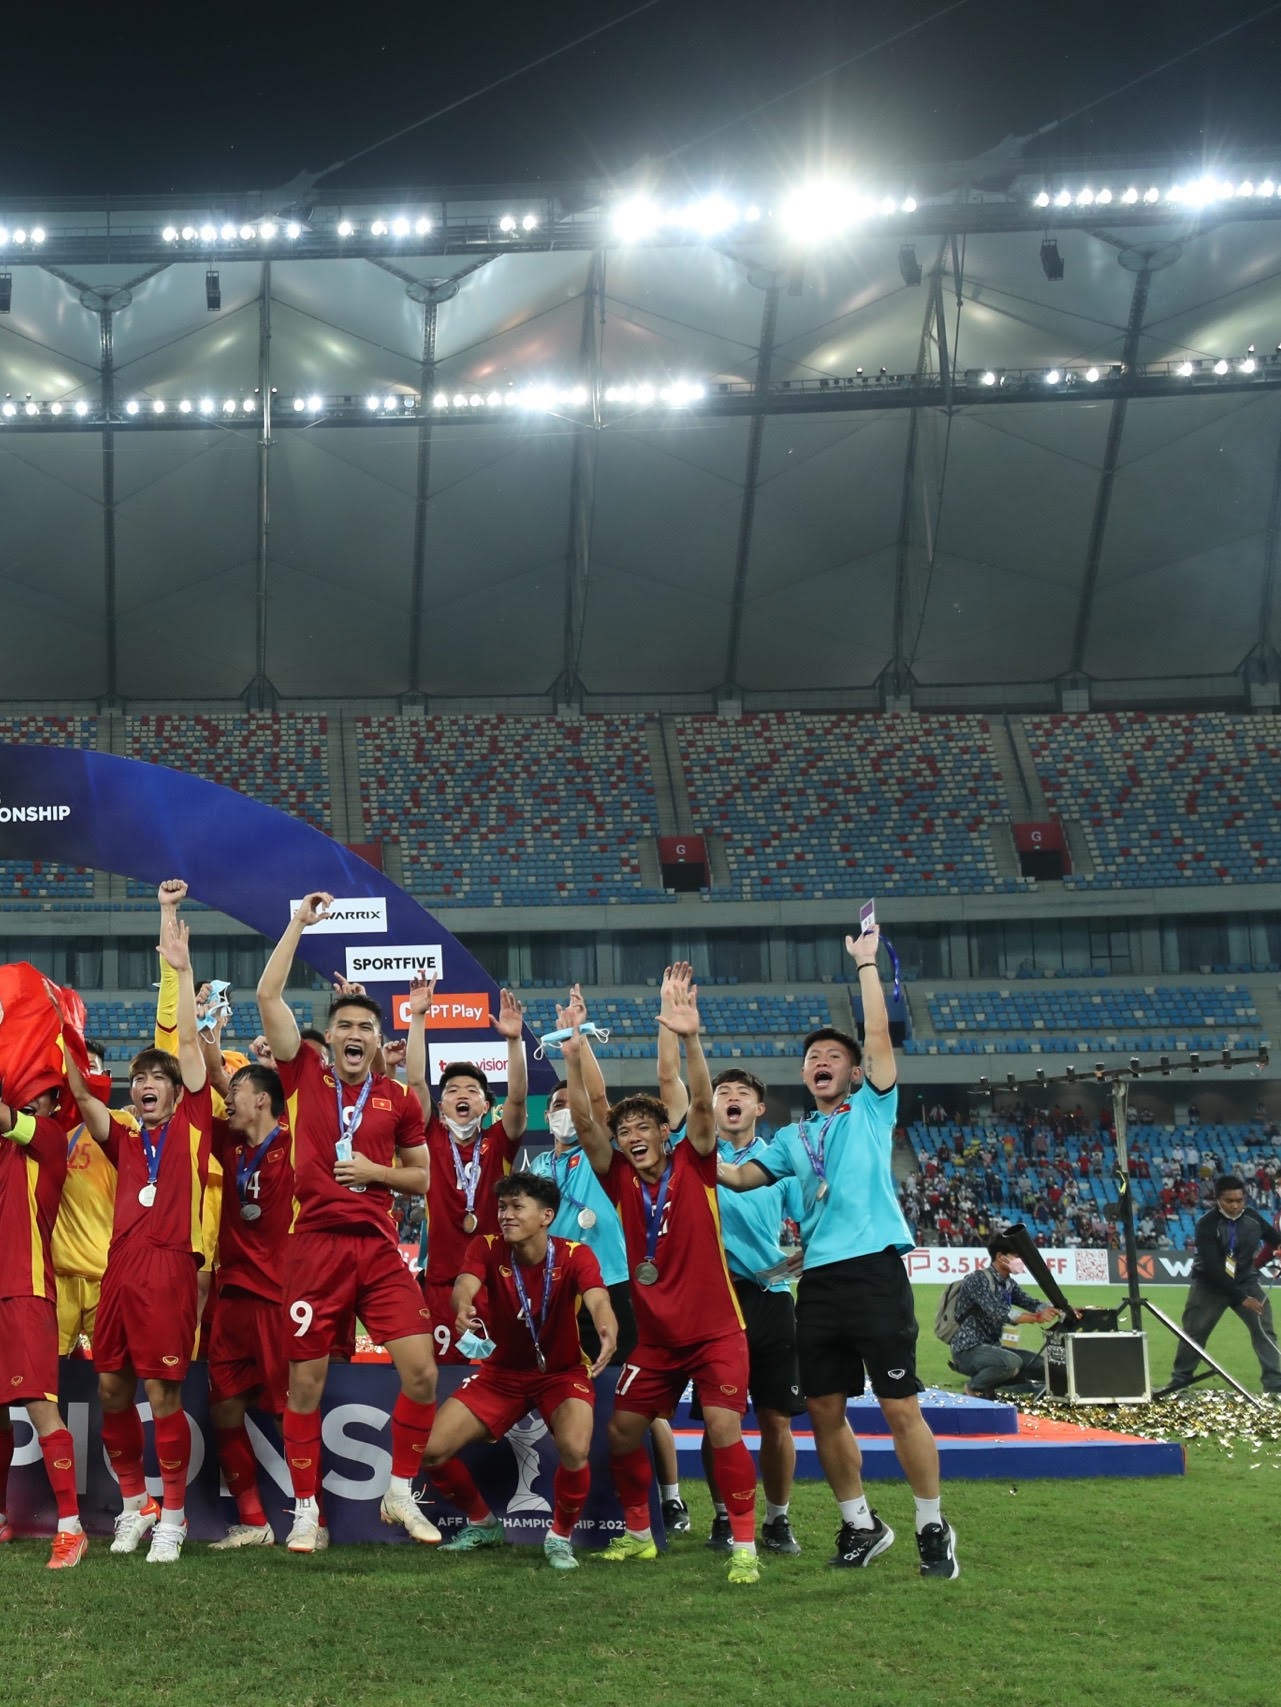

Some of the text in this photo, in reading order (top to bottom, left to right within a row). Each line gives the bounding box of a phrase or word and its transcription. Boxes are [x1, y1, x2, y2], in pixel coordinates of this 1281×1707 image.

[1031, 831, 1042, 841] G
[675, 844, 686, 855] G
[353, 956, 436, 971] SPORTFIVE
[430, 1004, 482, 1020] PT Play
[937, 1257, 969, 1274] 3.5
[289, 1300, 313, 1337] 9
[437, 1517, 462, 1527] AFF
[599, 1520, 627, 1530] 202
